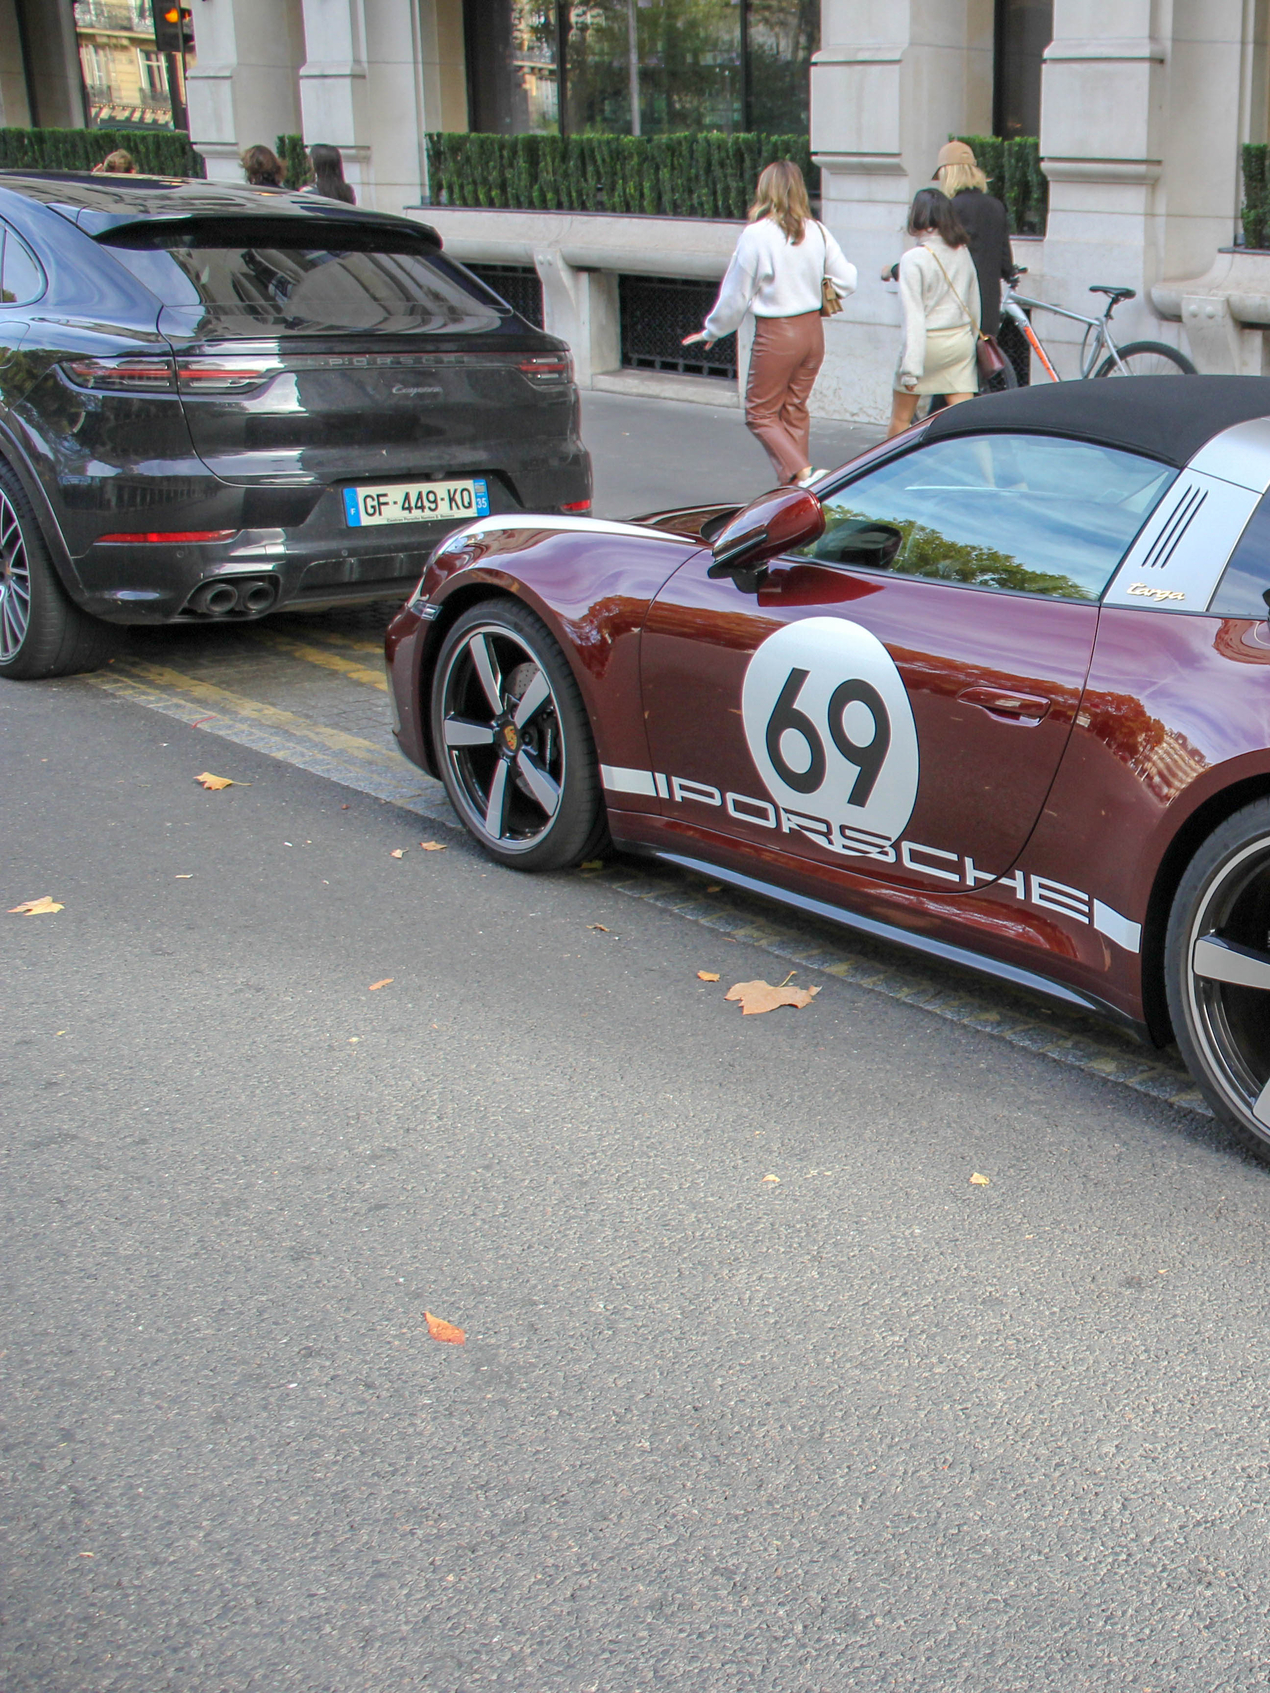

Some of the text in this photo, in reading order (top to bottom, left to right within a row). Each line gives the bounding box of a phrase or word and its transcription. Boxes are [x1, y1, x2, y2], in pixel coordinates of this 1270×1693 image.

[363, 487, 473, 516] GF-449-KQ
[476, 497, 488, 509] 35
[765, 667, 892, 808] 69
[673, 776, 1090, 924] PORSCHE
